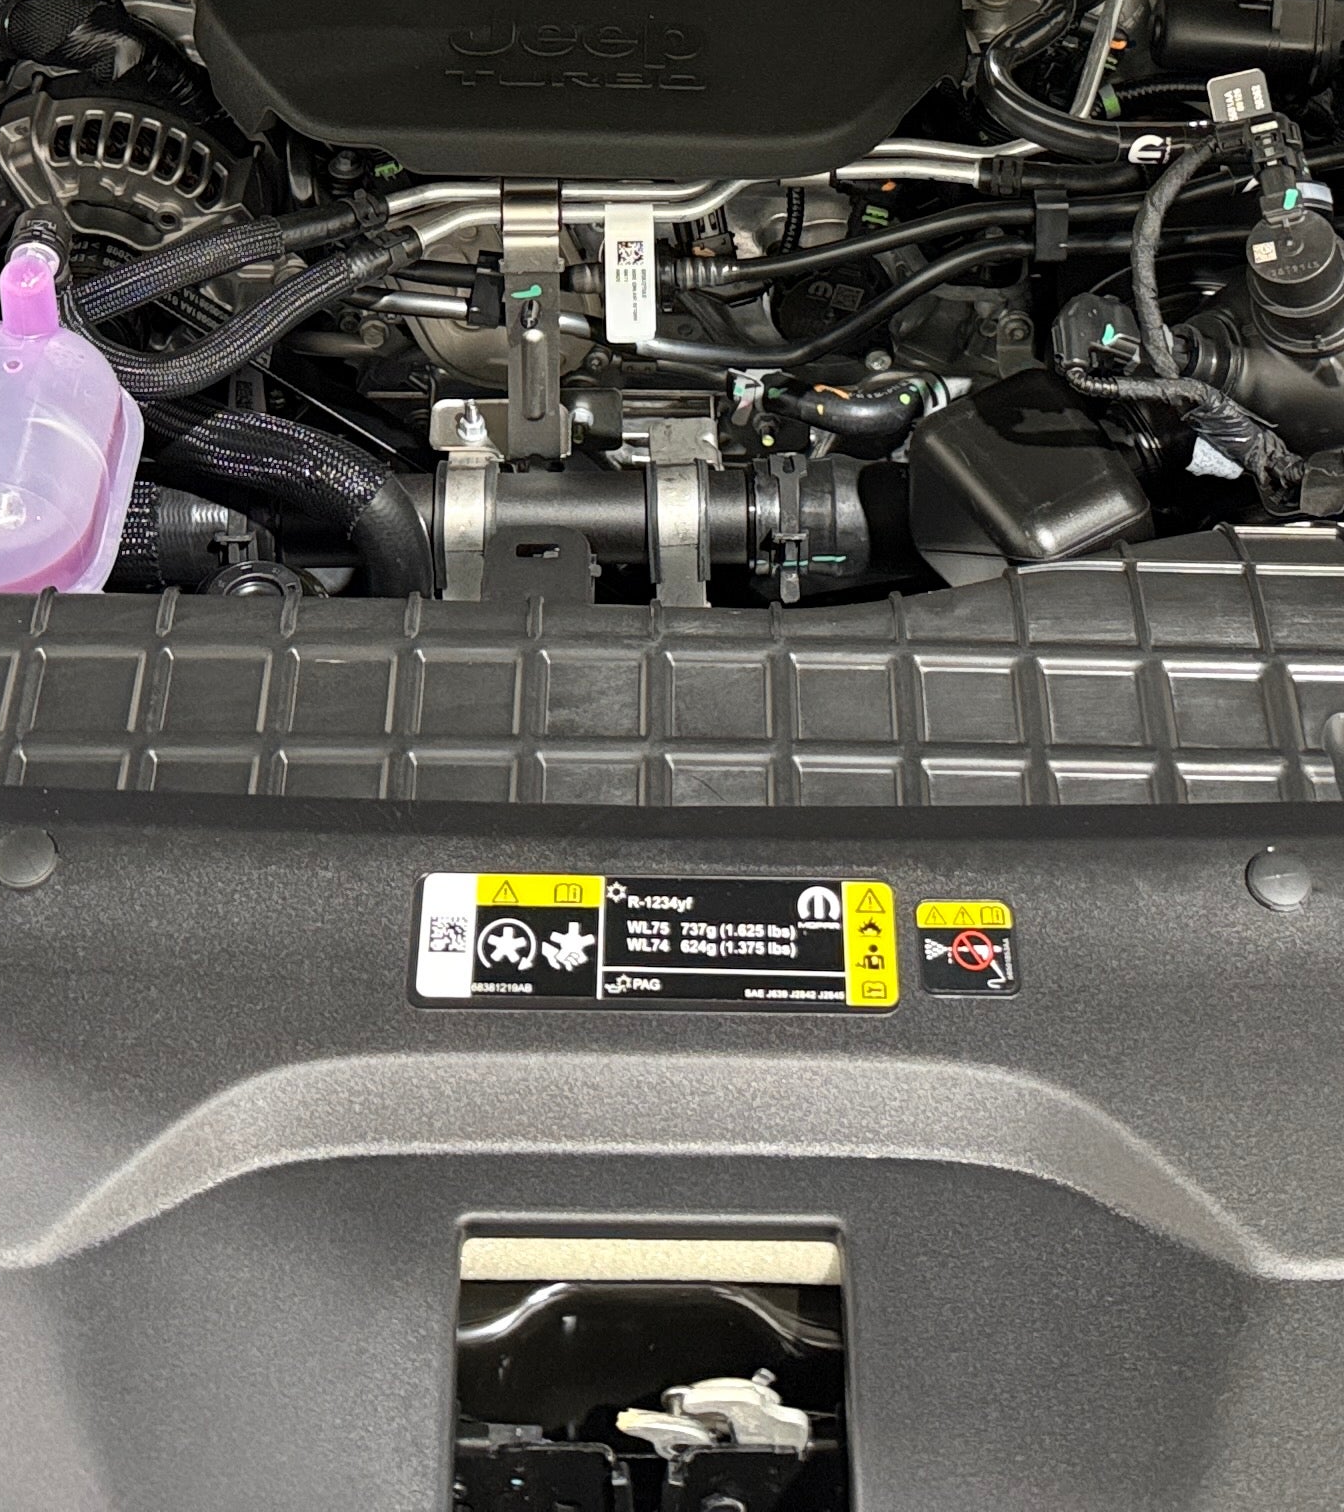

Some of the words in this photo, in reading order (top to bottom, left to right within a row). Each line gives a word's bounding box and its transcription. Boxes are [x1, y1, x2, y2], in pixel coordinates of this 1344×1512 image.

[448, 19, 705, 69] Jeep
[444, 70, 707, 91] TURBO
[627, 895, 694, 913] R-1234yf
[626, 920, 671, 935] WL75
[680, 922, 717, 939] 737g
[719, 923, 765, 938] (1.625
[767, 924, 797, 941] lbs)
[626, 937, 671, 953] WL74
[680, 940, 717, 956] 624g
[719, 940, 765, 956] (1.375
[767, 941, 798, 959] lbs)
[632, 977, 662, 991] PAG
[744, 988, 765, 999] SAE
